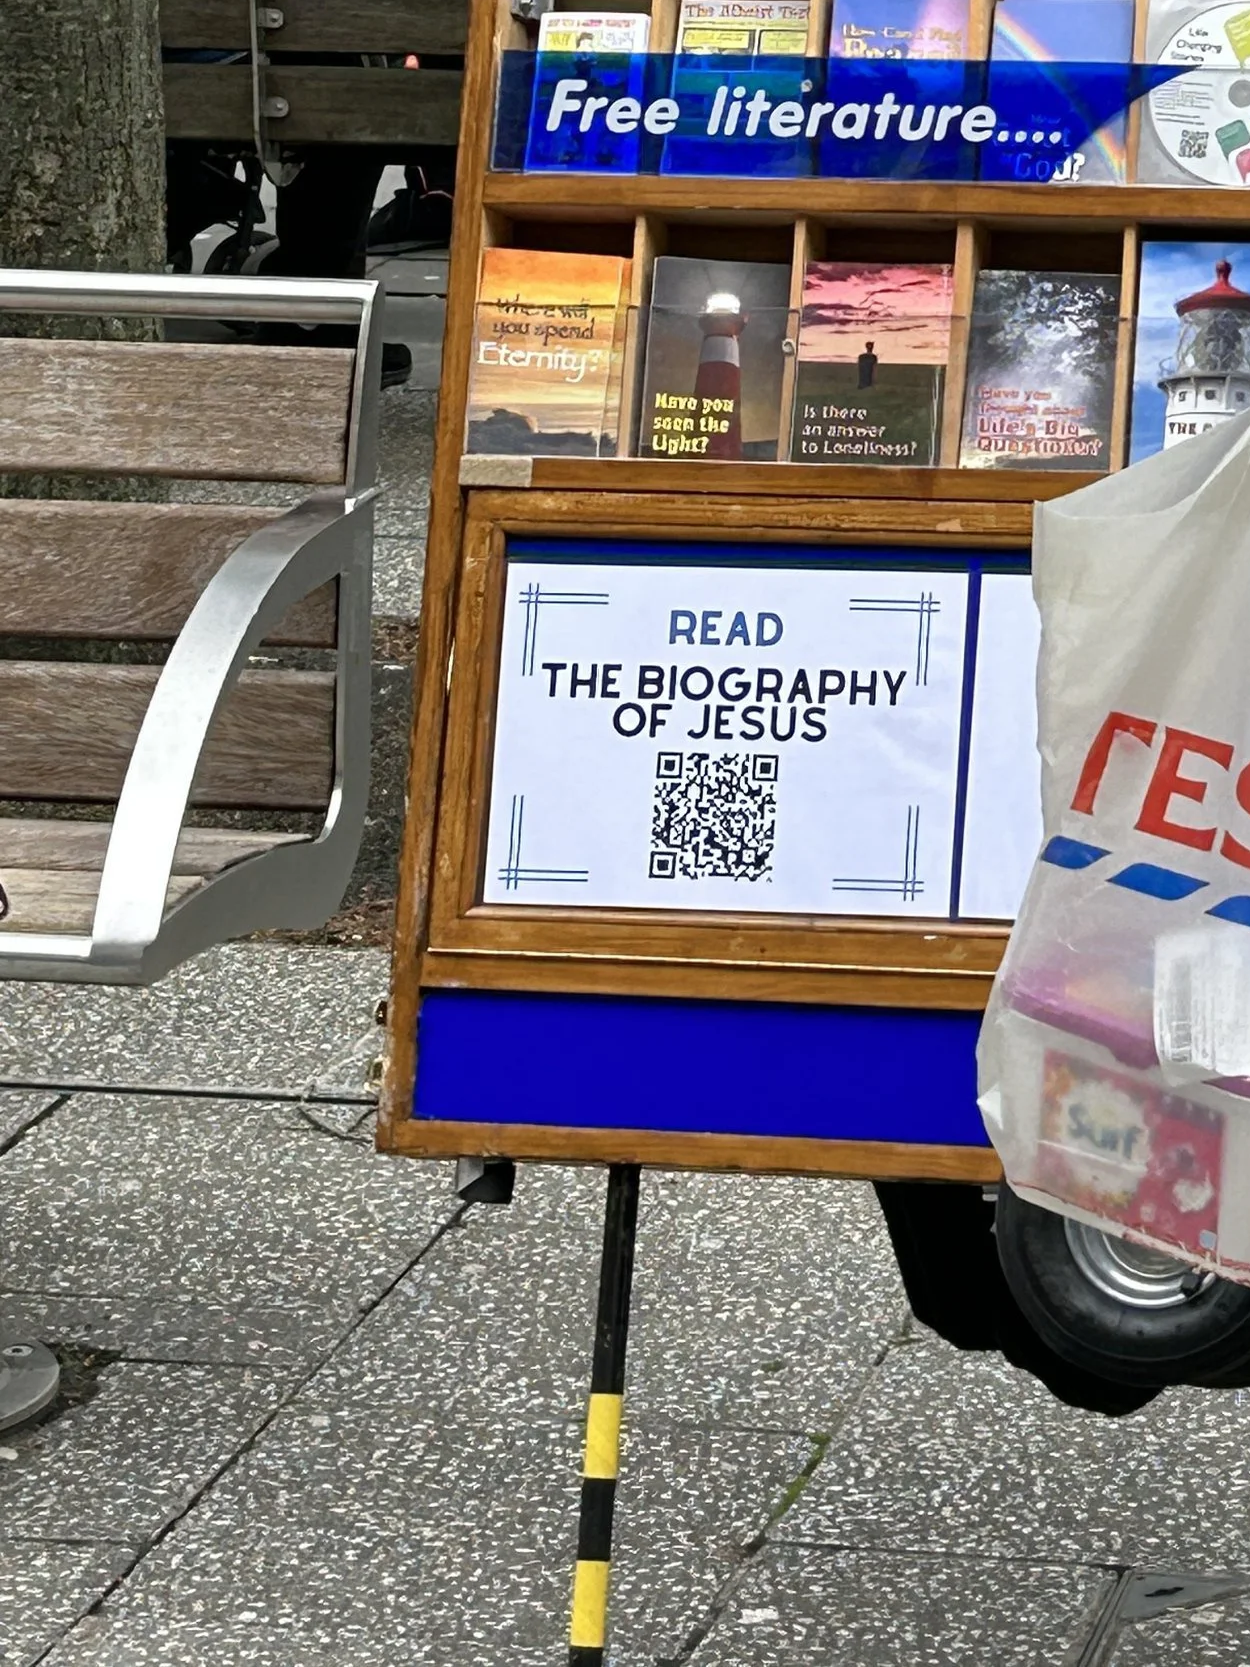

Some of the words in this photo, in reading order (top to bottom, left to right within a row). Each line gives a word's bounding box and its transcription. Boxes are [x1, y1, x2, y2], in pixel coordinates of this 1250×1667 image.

[545, 79, 680, 134] Free
[493, 322, 529, 340] you
[535, 317, 595, 346] spend
[477, 341, 602, 382] Eternity?
[654, 393, 697, 410] Have
[702, 398, 734, 414] you
[804, 404, 816, 419] Is
[822, 404, 868, 420] there
[653, 417, 695, 432] seen
[699, 415, 729, 433] the
[802, 424, 822, 437] an
[827, 423, 887, 438] answer
[1044, 419, 1080, 436] Big
[652, 435, 710, 455] Light?
[802, 441, 818, 454] to
[669, 609, 784, 647] READ
[541, 662, 622, 698] THE
[637, 665, 907, 706] BIOGRAPHY
[612, 702, 672, 738] OF
[687, 703, 828, 742] JESUS
